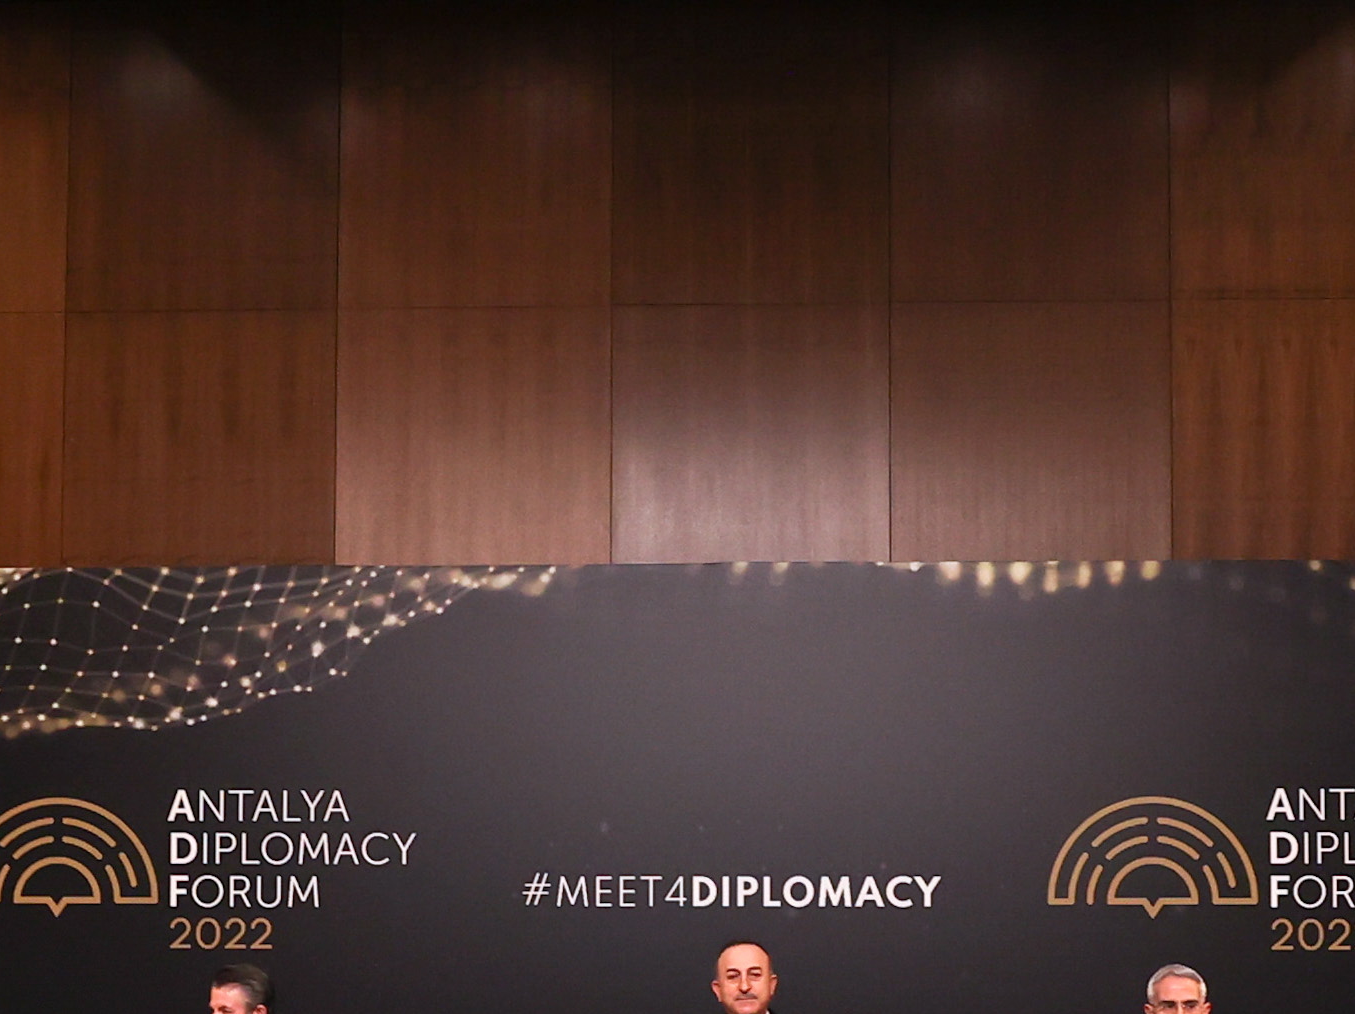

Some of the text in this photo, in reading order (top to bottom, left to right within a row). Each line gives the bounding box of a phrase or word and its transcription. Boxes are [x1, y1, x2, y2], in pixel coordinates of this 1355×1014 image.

[167, 789, 349, 822] ANTALYA
[168, 831, 417, 866] DIPLOMACY
[168, 873, 320, 908] FORUM
[521, 872, 942, 909] #MEET4DIPLOMACY
[169, 917, 273, 950] 2022
